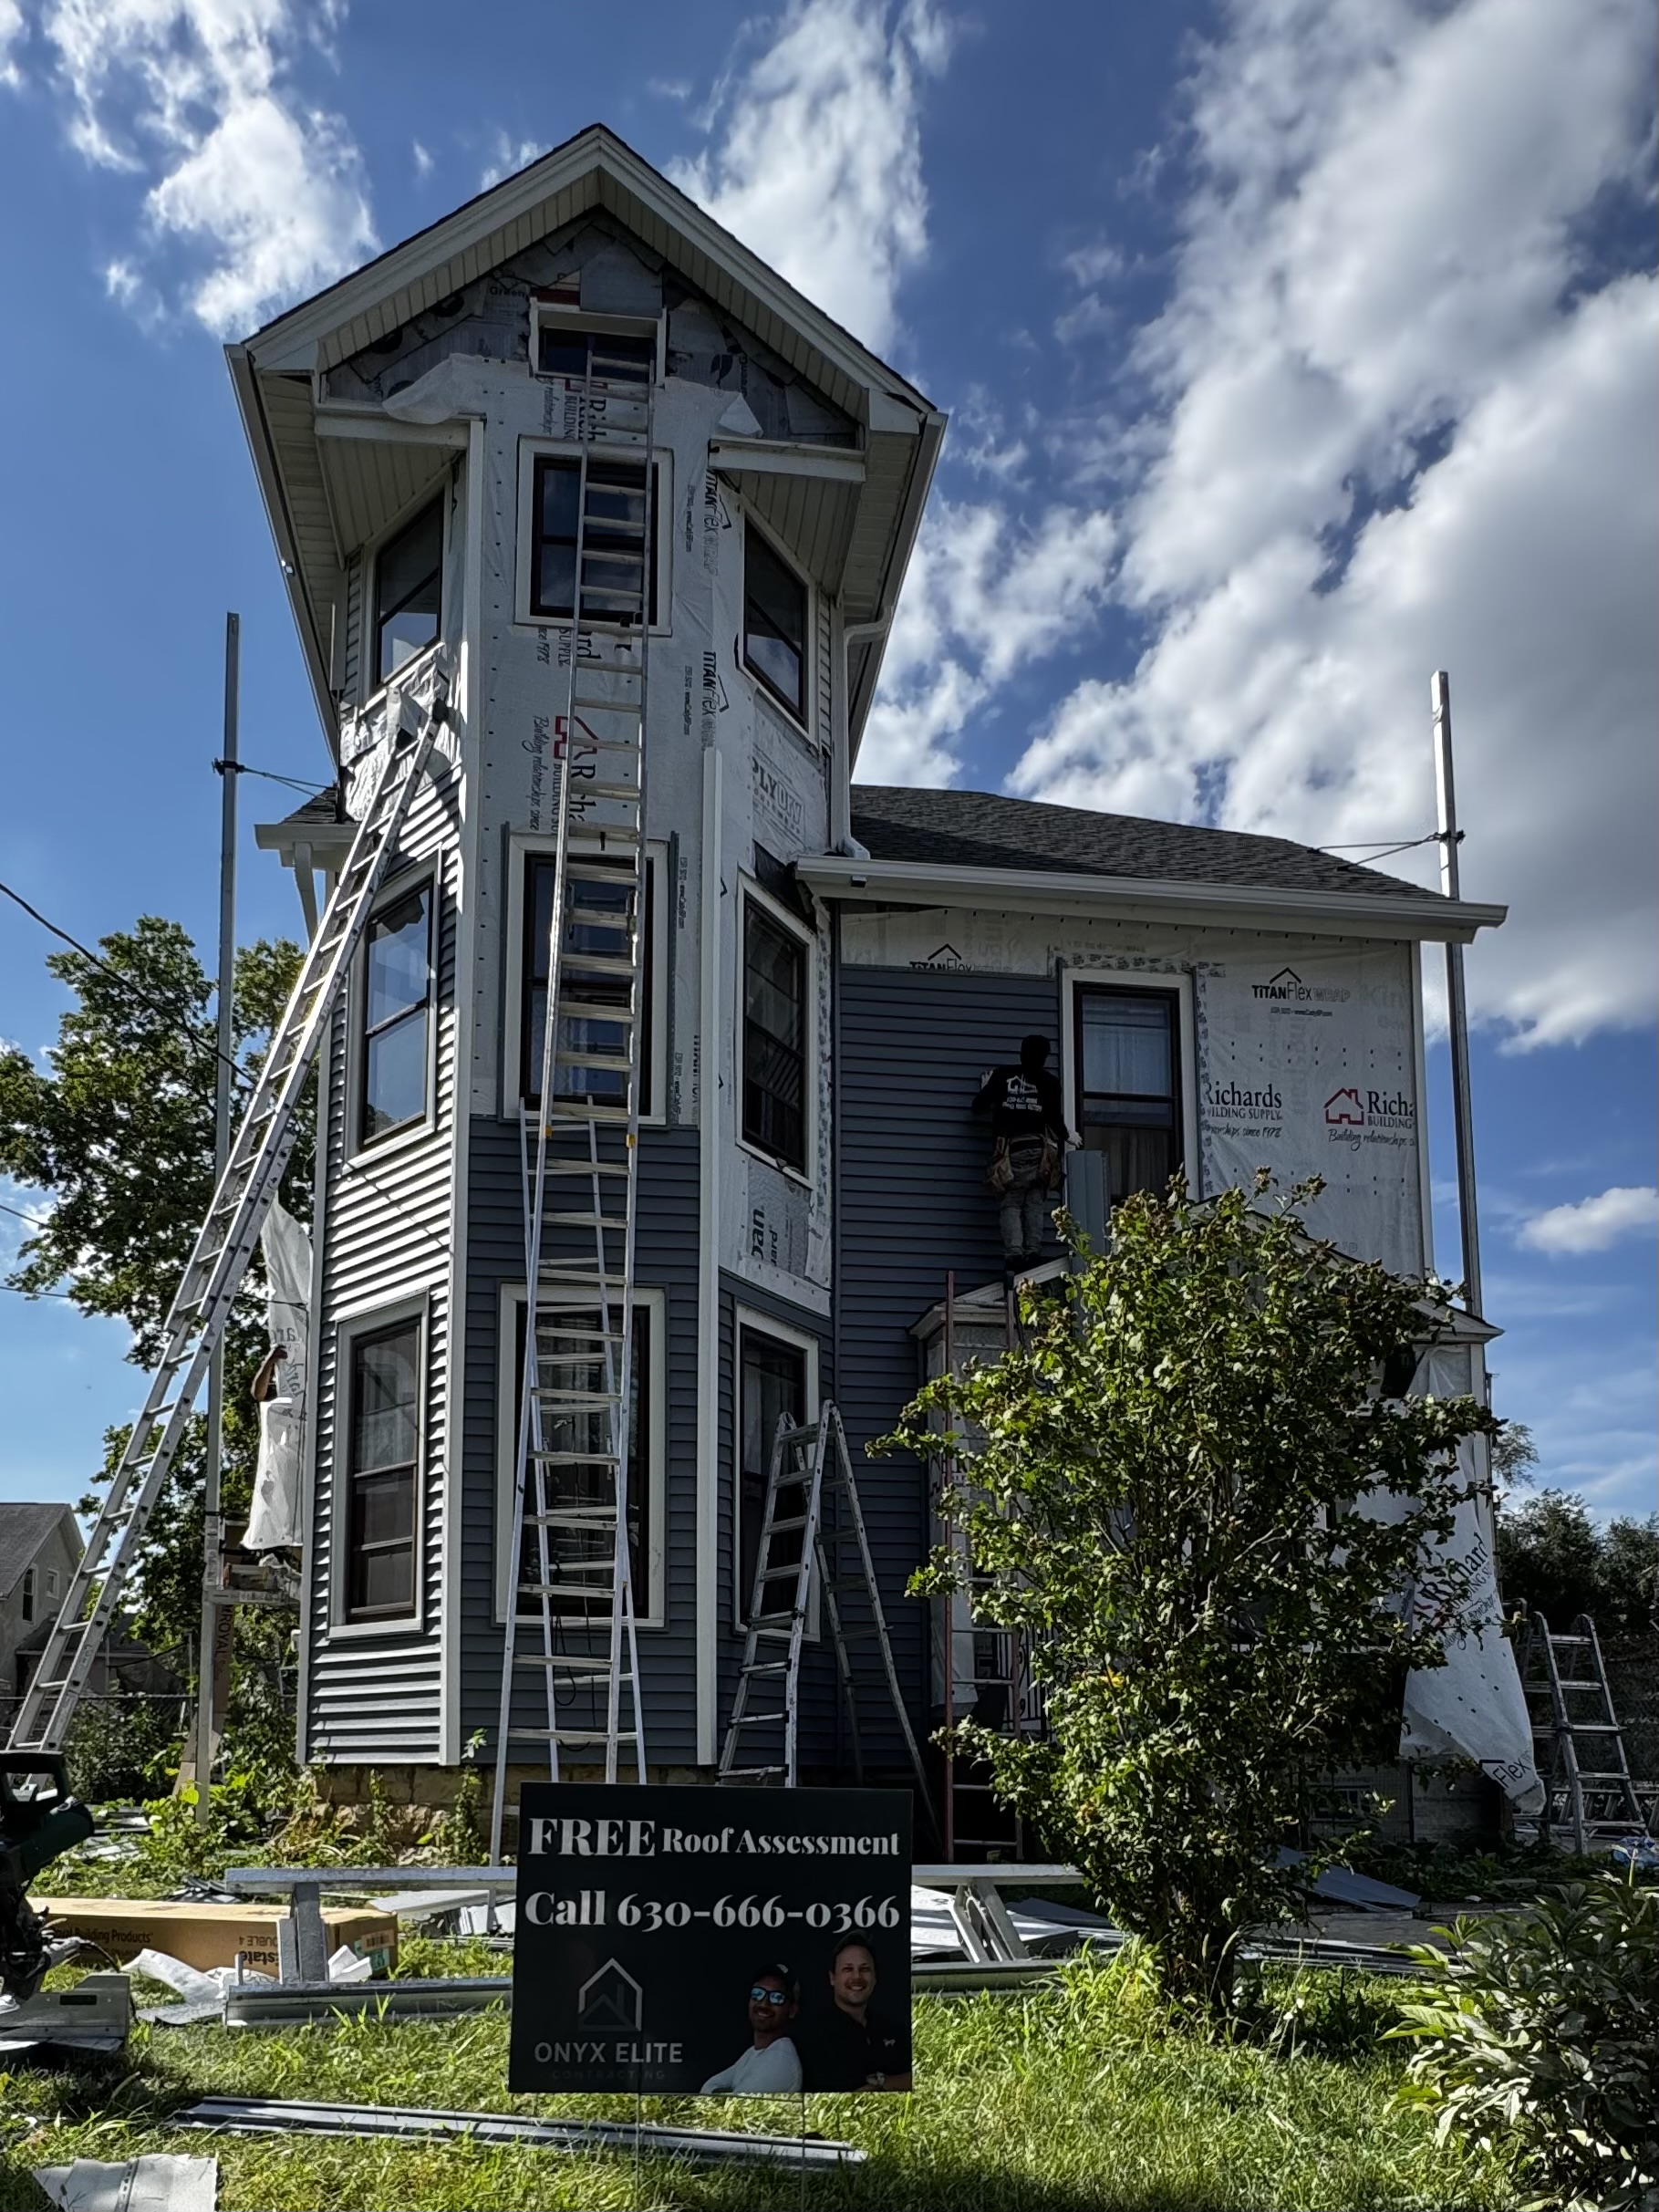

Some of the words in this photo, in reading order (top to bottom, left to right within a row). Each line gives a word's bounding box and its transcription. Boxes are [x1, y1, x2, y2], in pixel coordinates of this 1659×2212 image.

[1208, 1106, 1246, 1119] ILDING
[1367, 1116, 1413, 1129] BUILDING
[215, 1614, 232, 1657] ROYAL
[1493, 1757, 1531, 1788] Flex
[527, 1818, 656, 1856] FREE
[662, 1827, 734, 1854] Roof
[736, 1830, 900, 1855] Assessment
[524, 1890, 606, 1926] Call
[617, 1893, 900, 1933] 630-666-0366
[112, 1929, 151, 1944] Products
[534, 2042, 606, 2063] ONYX
[616, 2042, 683, 2063] ELITE
[552, 2070, 665, 2081] CONTRACTNG
